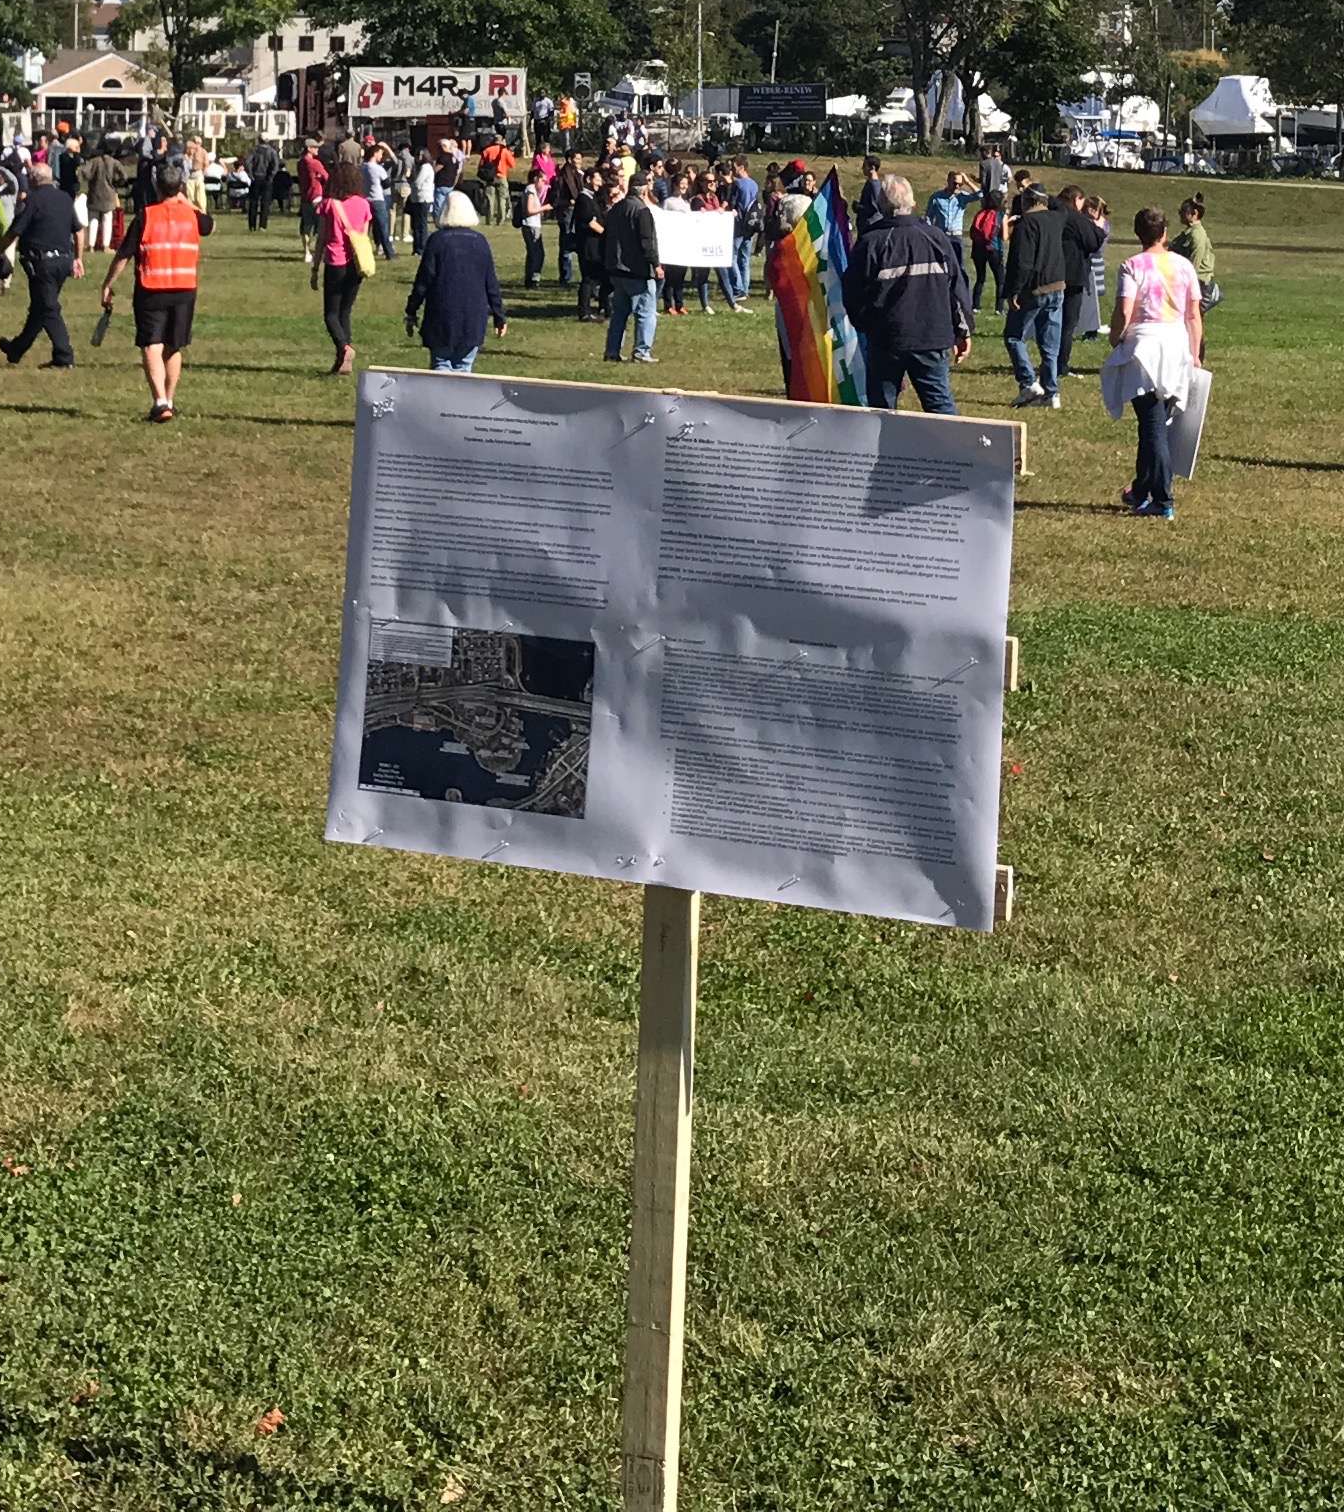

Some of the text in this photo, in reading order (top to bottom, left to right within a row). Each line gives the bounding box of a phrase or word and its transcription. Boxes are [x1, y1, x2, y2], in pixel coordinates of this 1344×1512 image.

[393, 74, 518, 97] M4RJ RI
[392, 99, 461, 110] MARCH 4 RACIA
